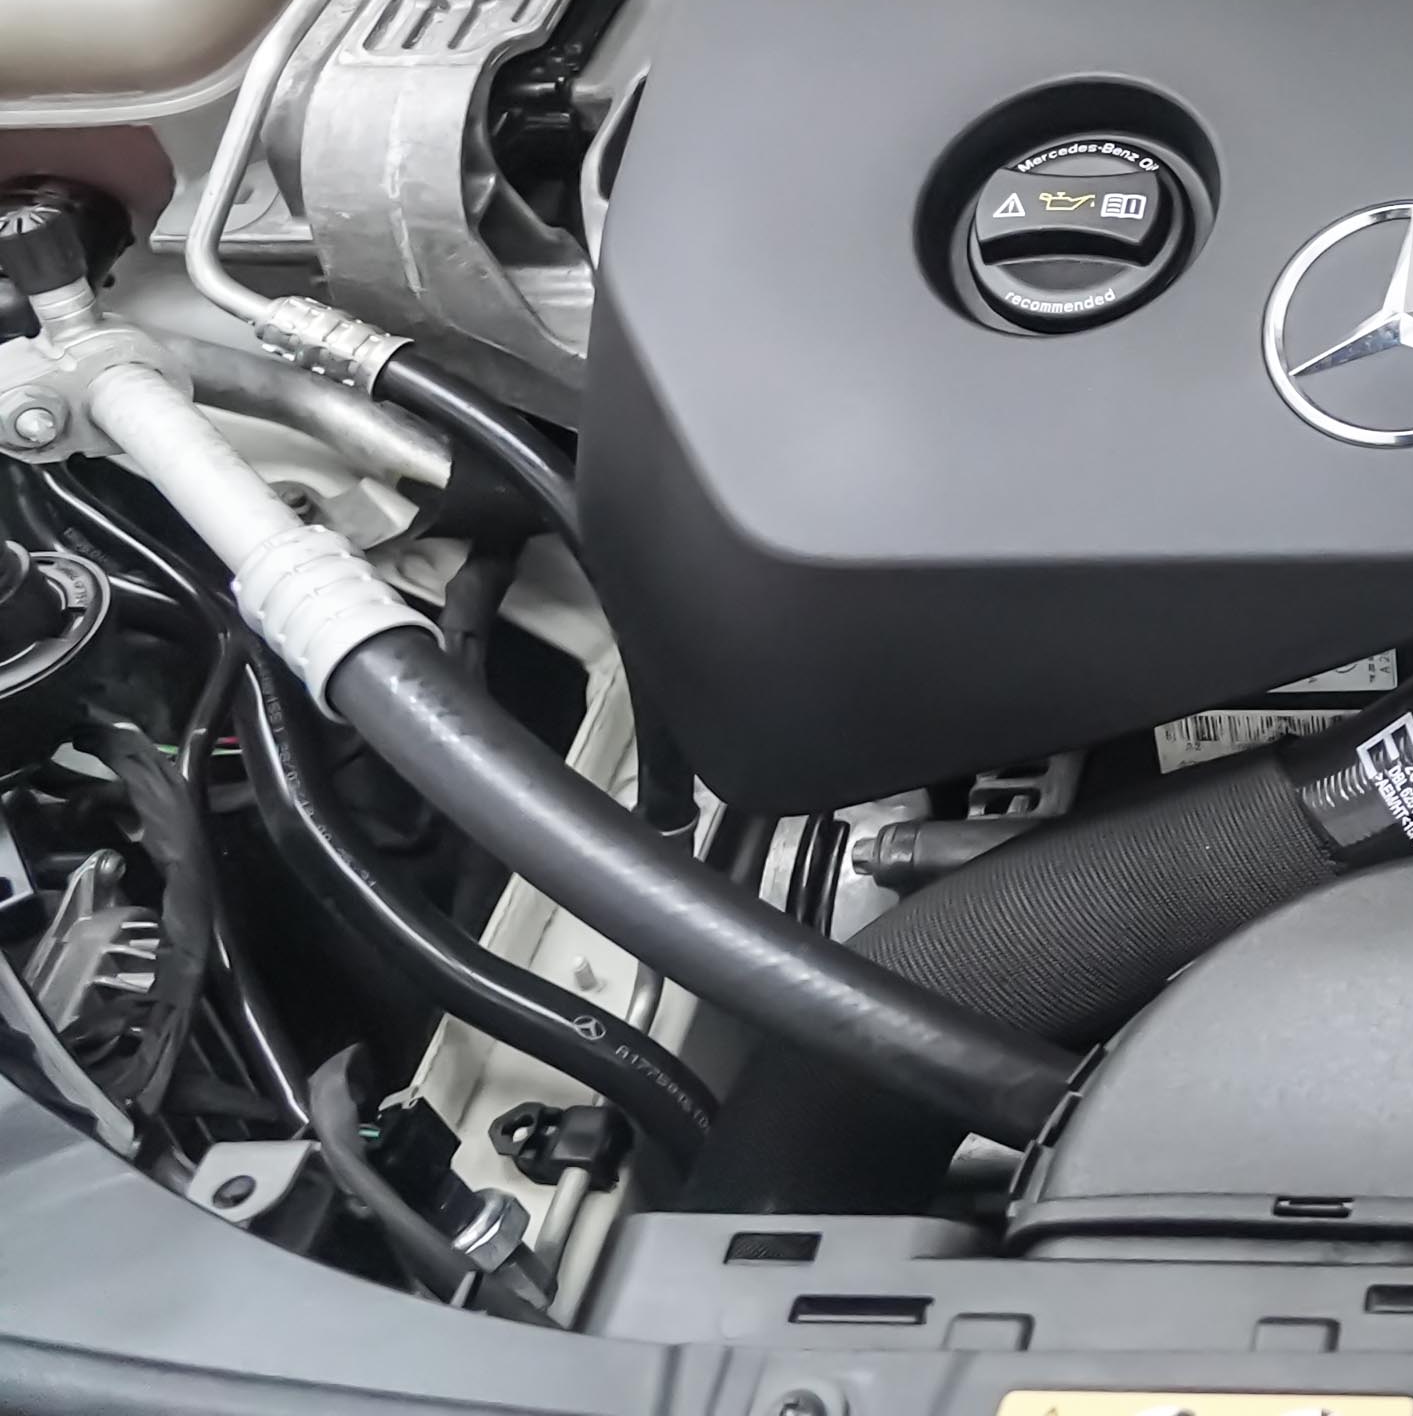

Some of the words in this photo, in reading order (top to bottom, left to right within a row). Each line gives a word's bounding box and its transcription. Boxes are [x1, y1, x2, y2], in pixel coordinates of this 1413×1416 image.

[1018, 142, 1140, 172] Mercedes-Benz
[1004, 288, 1117, 313] recommended
[1388, 765, 1408, 791] DBL
